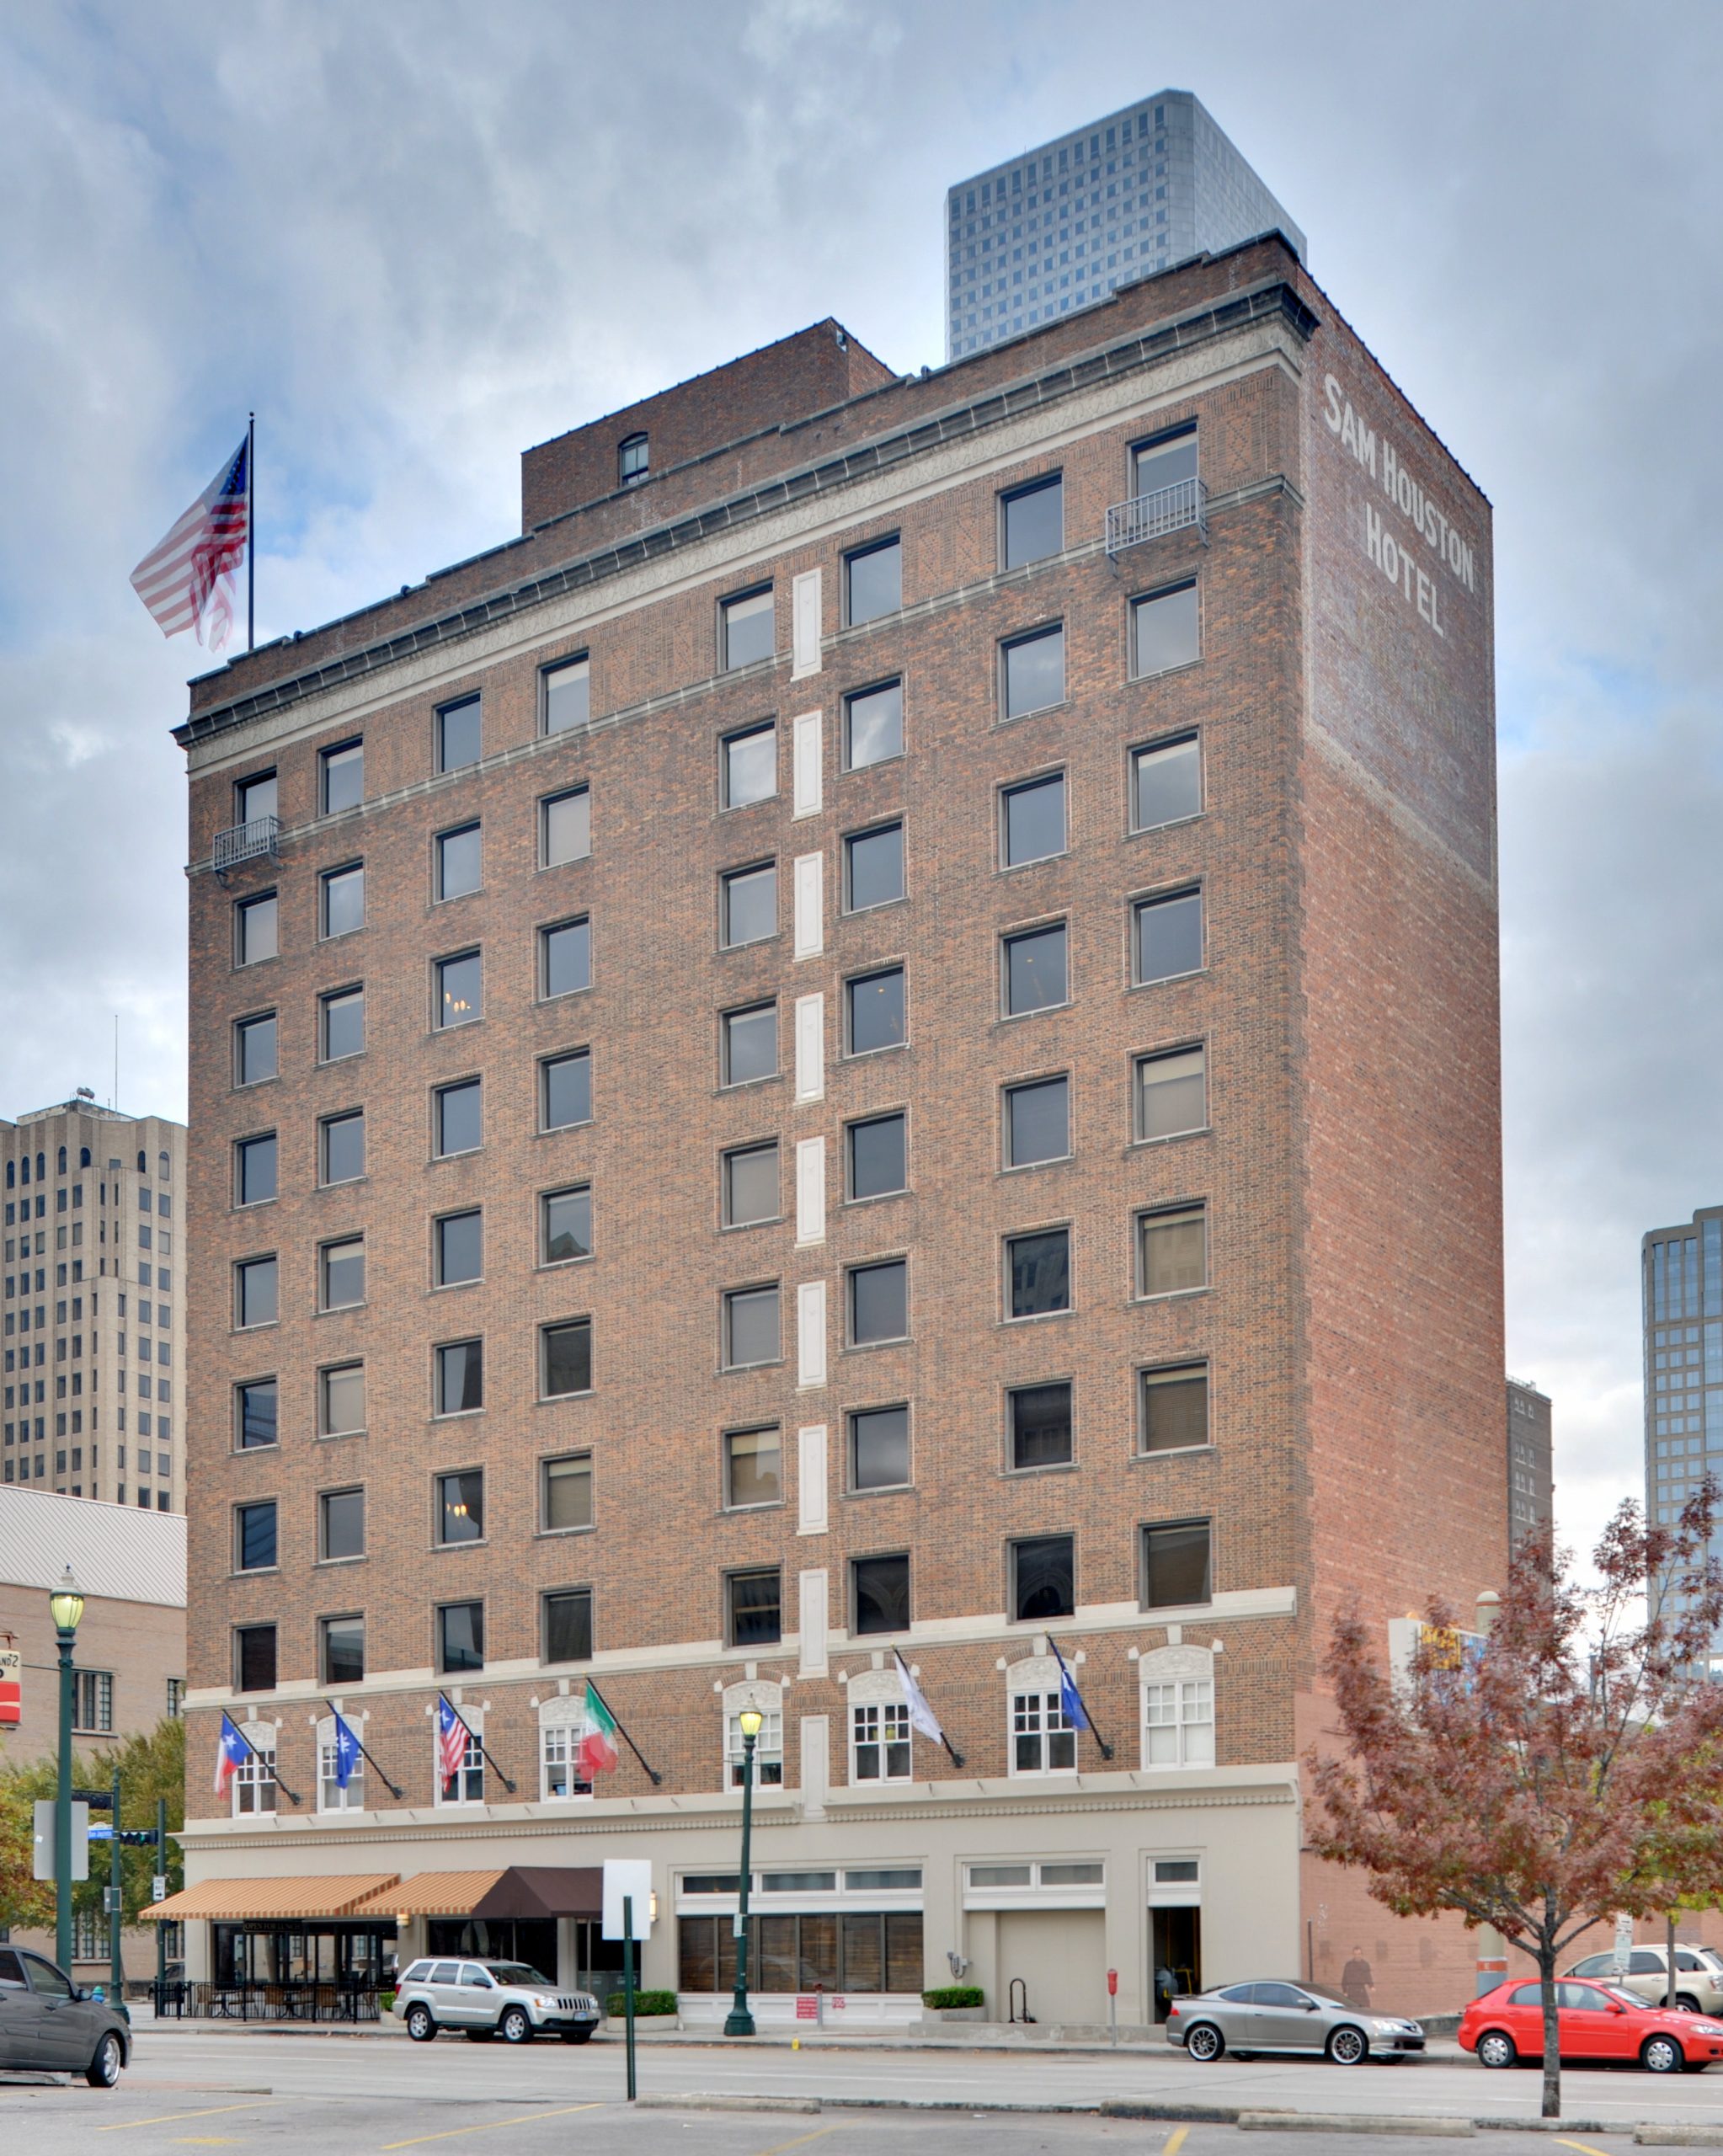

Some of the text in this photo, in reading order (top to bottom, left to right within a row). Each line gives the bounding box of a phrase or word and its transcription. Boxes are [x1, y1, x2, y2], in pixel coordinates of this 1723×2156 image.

[1324, 373, 1475, 593] SAM HOUSTON
[1366, 501, 1443, 638] HOTEL
